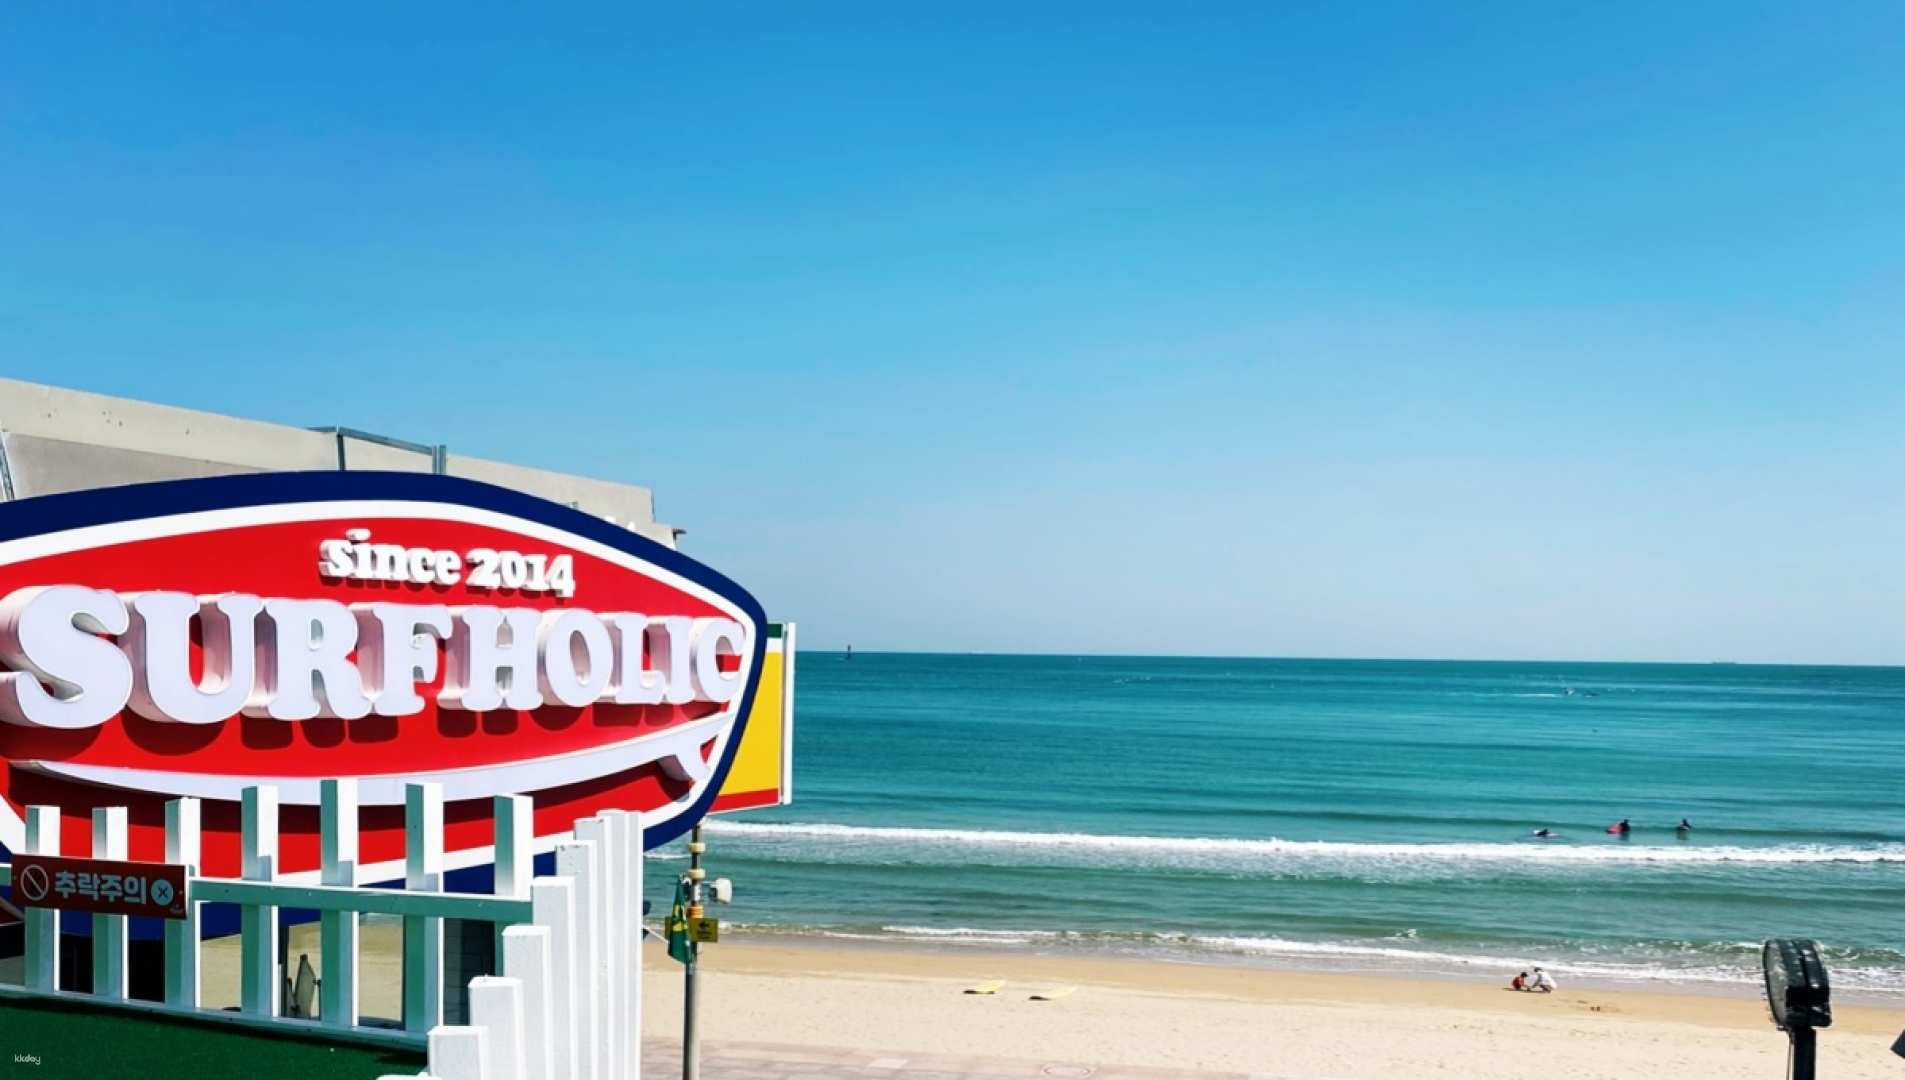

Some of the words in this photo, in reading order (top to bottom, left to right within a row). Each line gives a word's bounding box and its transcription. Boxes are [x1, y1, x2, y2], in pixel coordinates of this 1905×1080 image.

[320, 529, 461, 585] since
[467, 547, 575, 598] 2014
[3, 584, 746, 729] SURFHOLIC
[55, 871, 147, 904] 추락주의
